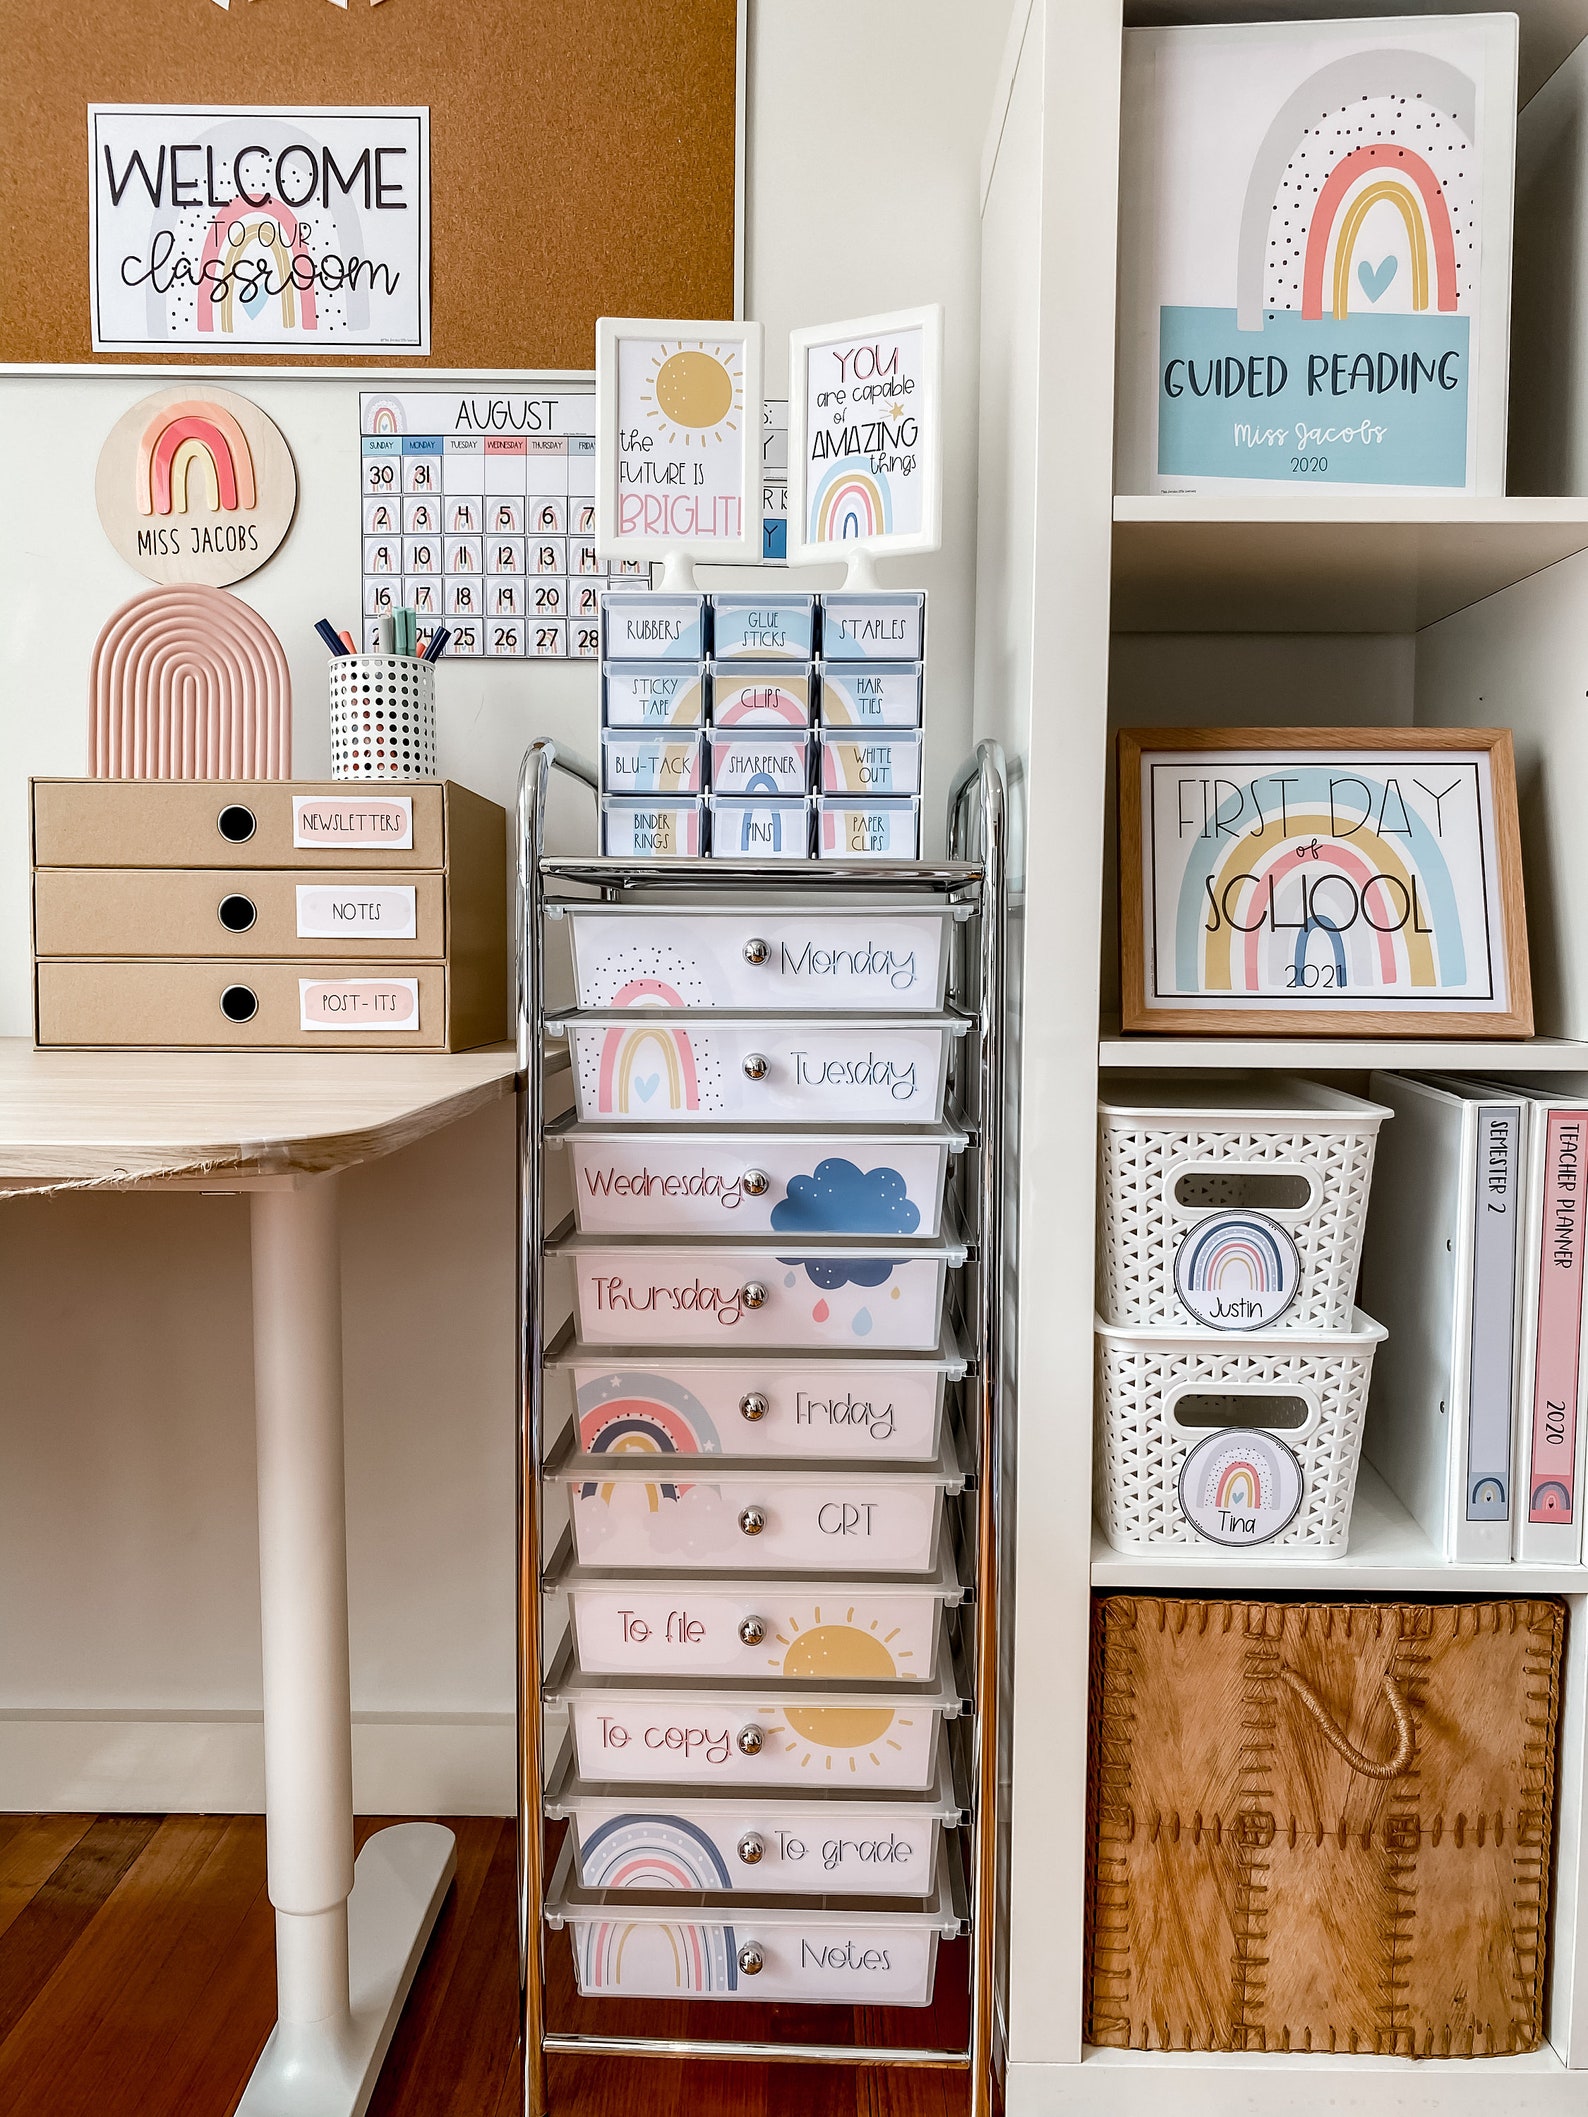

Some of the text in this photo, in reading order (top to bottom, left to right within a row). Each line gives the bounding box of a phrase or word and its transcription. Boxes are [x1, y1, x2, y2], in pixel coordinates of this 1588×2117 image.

[104, 144, 407, 209] WELCOME
[207, 220, 311, 248] TO OUR
[121, 231, 400, 303] classroom
[833, 345, 899, 383] YOU
[1164, 350, 1460, 399] GUIDED READING
[817, 375, 915, 408] are capable
[455, 400, 559, 430] AUGUST
[833, 407, 847, 424] of
[369, 441, 595, 450] SUNDAY MONDAY TUESDAY WEDNESDAY THURSDAY FRIDA
[620, 429, 653, 452] the
[812, 417, 919, 460] AMAZING
[1233, 419, 1388, 451] Miss Jacobs
[369, 465, 430, 485] 30 31
[620, 462, 704, 485] FUTURE IS
[870, 452, 917, 476] things
[1290, 456, 1328, 473] 2020
[377, 506, 595, 525] 2 3 4 5 6 7
[137, 525, 258, 556] MISS JACOBS
[378, 546, 595, 565] 9 10 11 12 13 14
[375, 587, 596, 607] 16 17 18 19 20 21
[627, 620, 681, 640] RUBBERS
[748, 611, 778, 628] GLUE
[839, 619, 906, 640] STAPLES
[454, 627, 475, 646] 25
[494, 628, 517, 646] 26
[536, 628, 559, 647] 27
[578, 629, 598, 648] 28
[742, 631, 786, 647] STICKS
[632, 678, 678, 695] STICKY
[857, 678, 884, 695] HAIR
[639, 699, 669, 716] TAPE
[741, 688, 780, 708] CLIPS
[858, 698, 883, 714] TIES
[615, 756, 691, 775] BLU-TACK
[729, 755, 796, 775] SHARPENER
[855, 748, 892, 764] WHITE
[859, 767, 890, 783] OUT
[1178, 777, 1462, 838] FIRST DAY
[303, 813, 400, 831] NEWSLETTERS
[634, 813, 670, 830] BINDER
[747, 822, 773, 842] PINS
[853, 816, 885, 833] PAPER
[634, 833, 669, 849] RINGS
[851, 836, 883, 851] CLIPS
[1295, 838, 1323, 860] of
[333, 903, 381, 920] NOTES
[1204, 873, 1433, 934] SCHOOL
[780, 940, 917, 989] Monday
[1284, 964, 1345, 990] 2021
[790, 1051, 919, 1100] Tuesday
[1487, 1120, 1509, 1214] SEMESTER 2
[584, 1167, 745, 1209] Wednesday
[1554, 1124, 1580, 1269] TEACHER PLANNER
[591, 1276, 744, 1326] Thursday
[1209, 1297, 1263, 1319] Justin
[795, 1392, 897, 1440] Friday
[1545, 1400, 1566, 1445] 2020
[817, 1502, 879, 1536] CRT
[1217, 1510, 1256, 1534] Tina
[617, 1610, 705, 1643] To file
[597, 1717, 732, 1764] To copy
[774, 1830, 913, 1870] To grade
[800, 1939, 892, 1971] Notes
